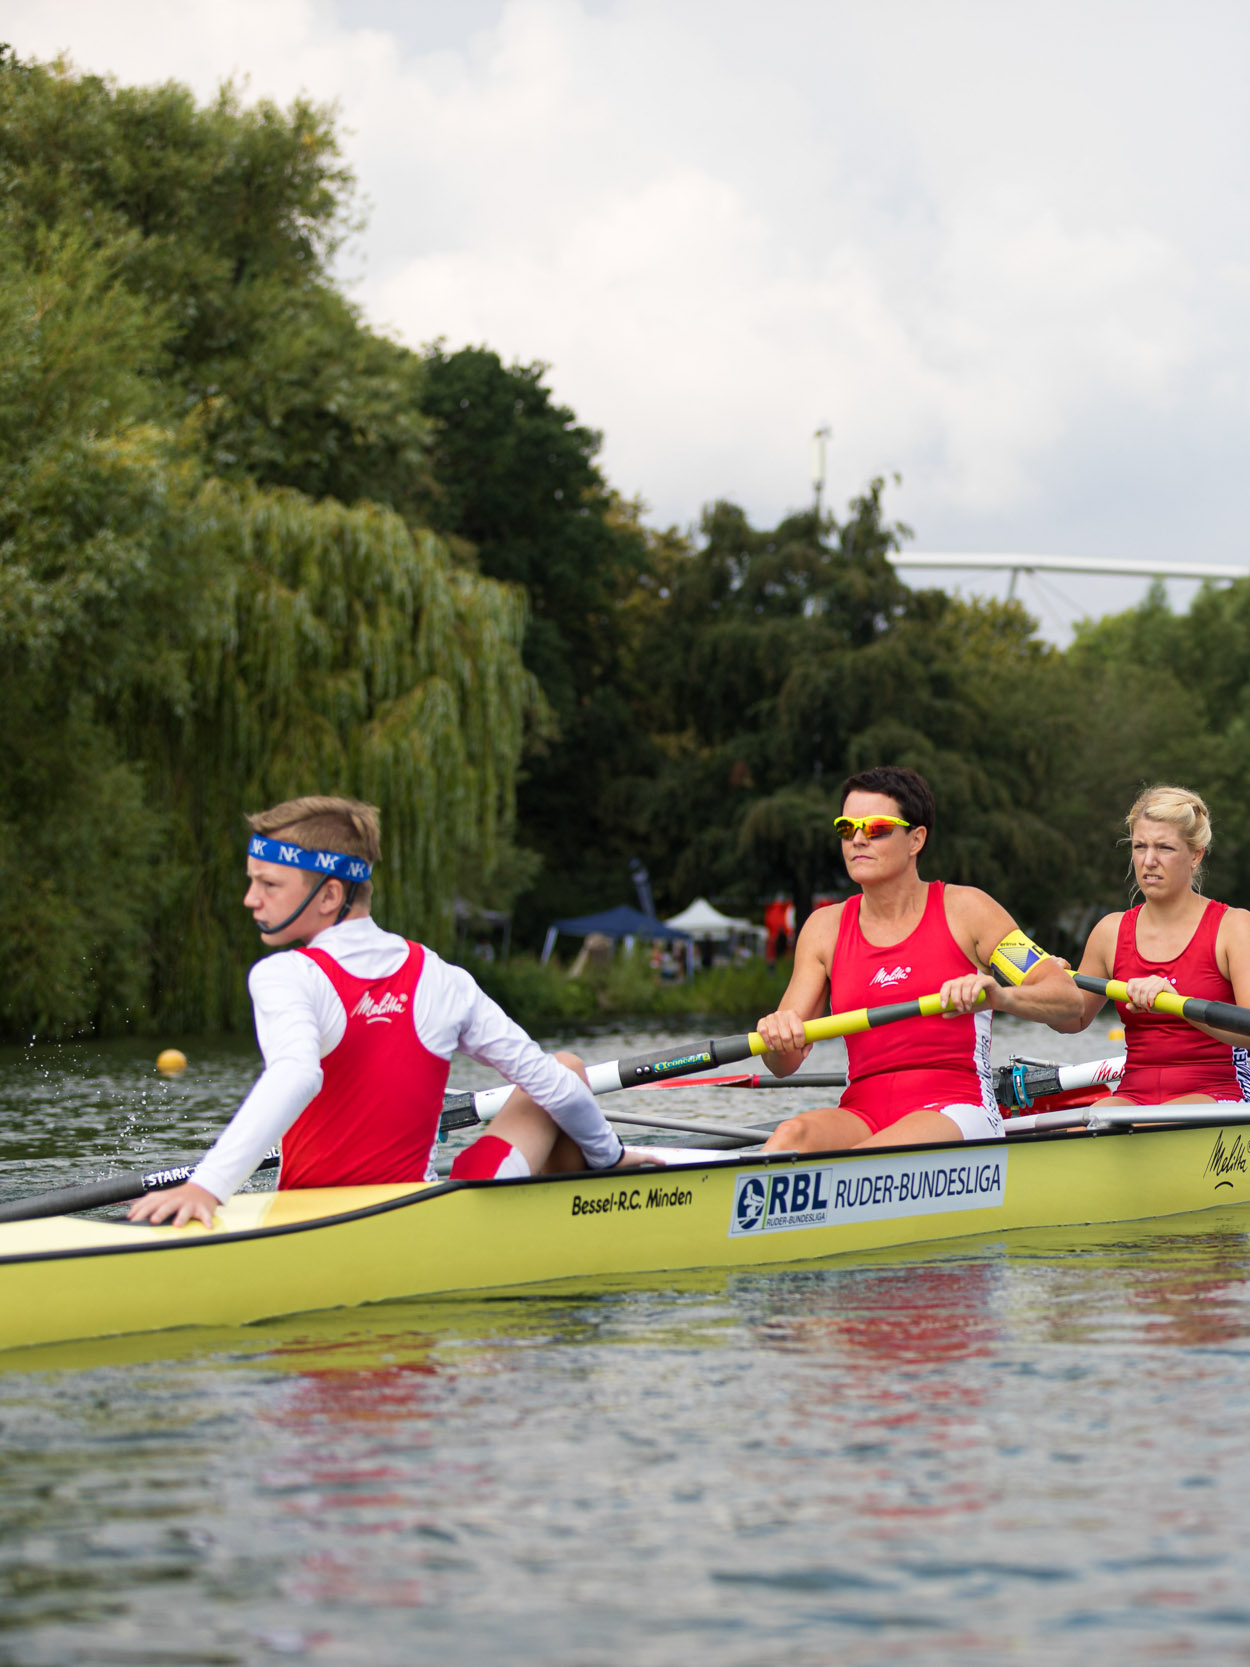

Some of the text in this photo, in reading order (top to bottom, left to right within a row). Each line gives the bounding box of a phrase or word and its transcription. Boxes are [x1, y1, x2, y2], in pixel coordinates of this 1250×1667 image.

[250, 838, 268, 857] NK
[278, 846, 303, 864] NK
[315, 853, 340, 870] NK
[346, 862, 366, 878] NK
[646, 1186, 692, 1208] Minden
[768, 1172, 828, 1215] RBL
[834, 1164, 1001, 1209] RUDER-BUNDESLIGA
[766, 1212, 825, 1227] RUDER-BUNDESLIGA
